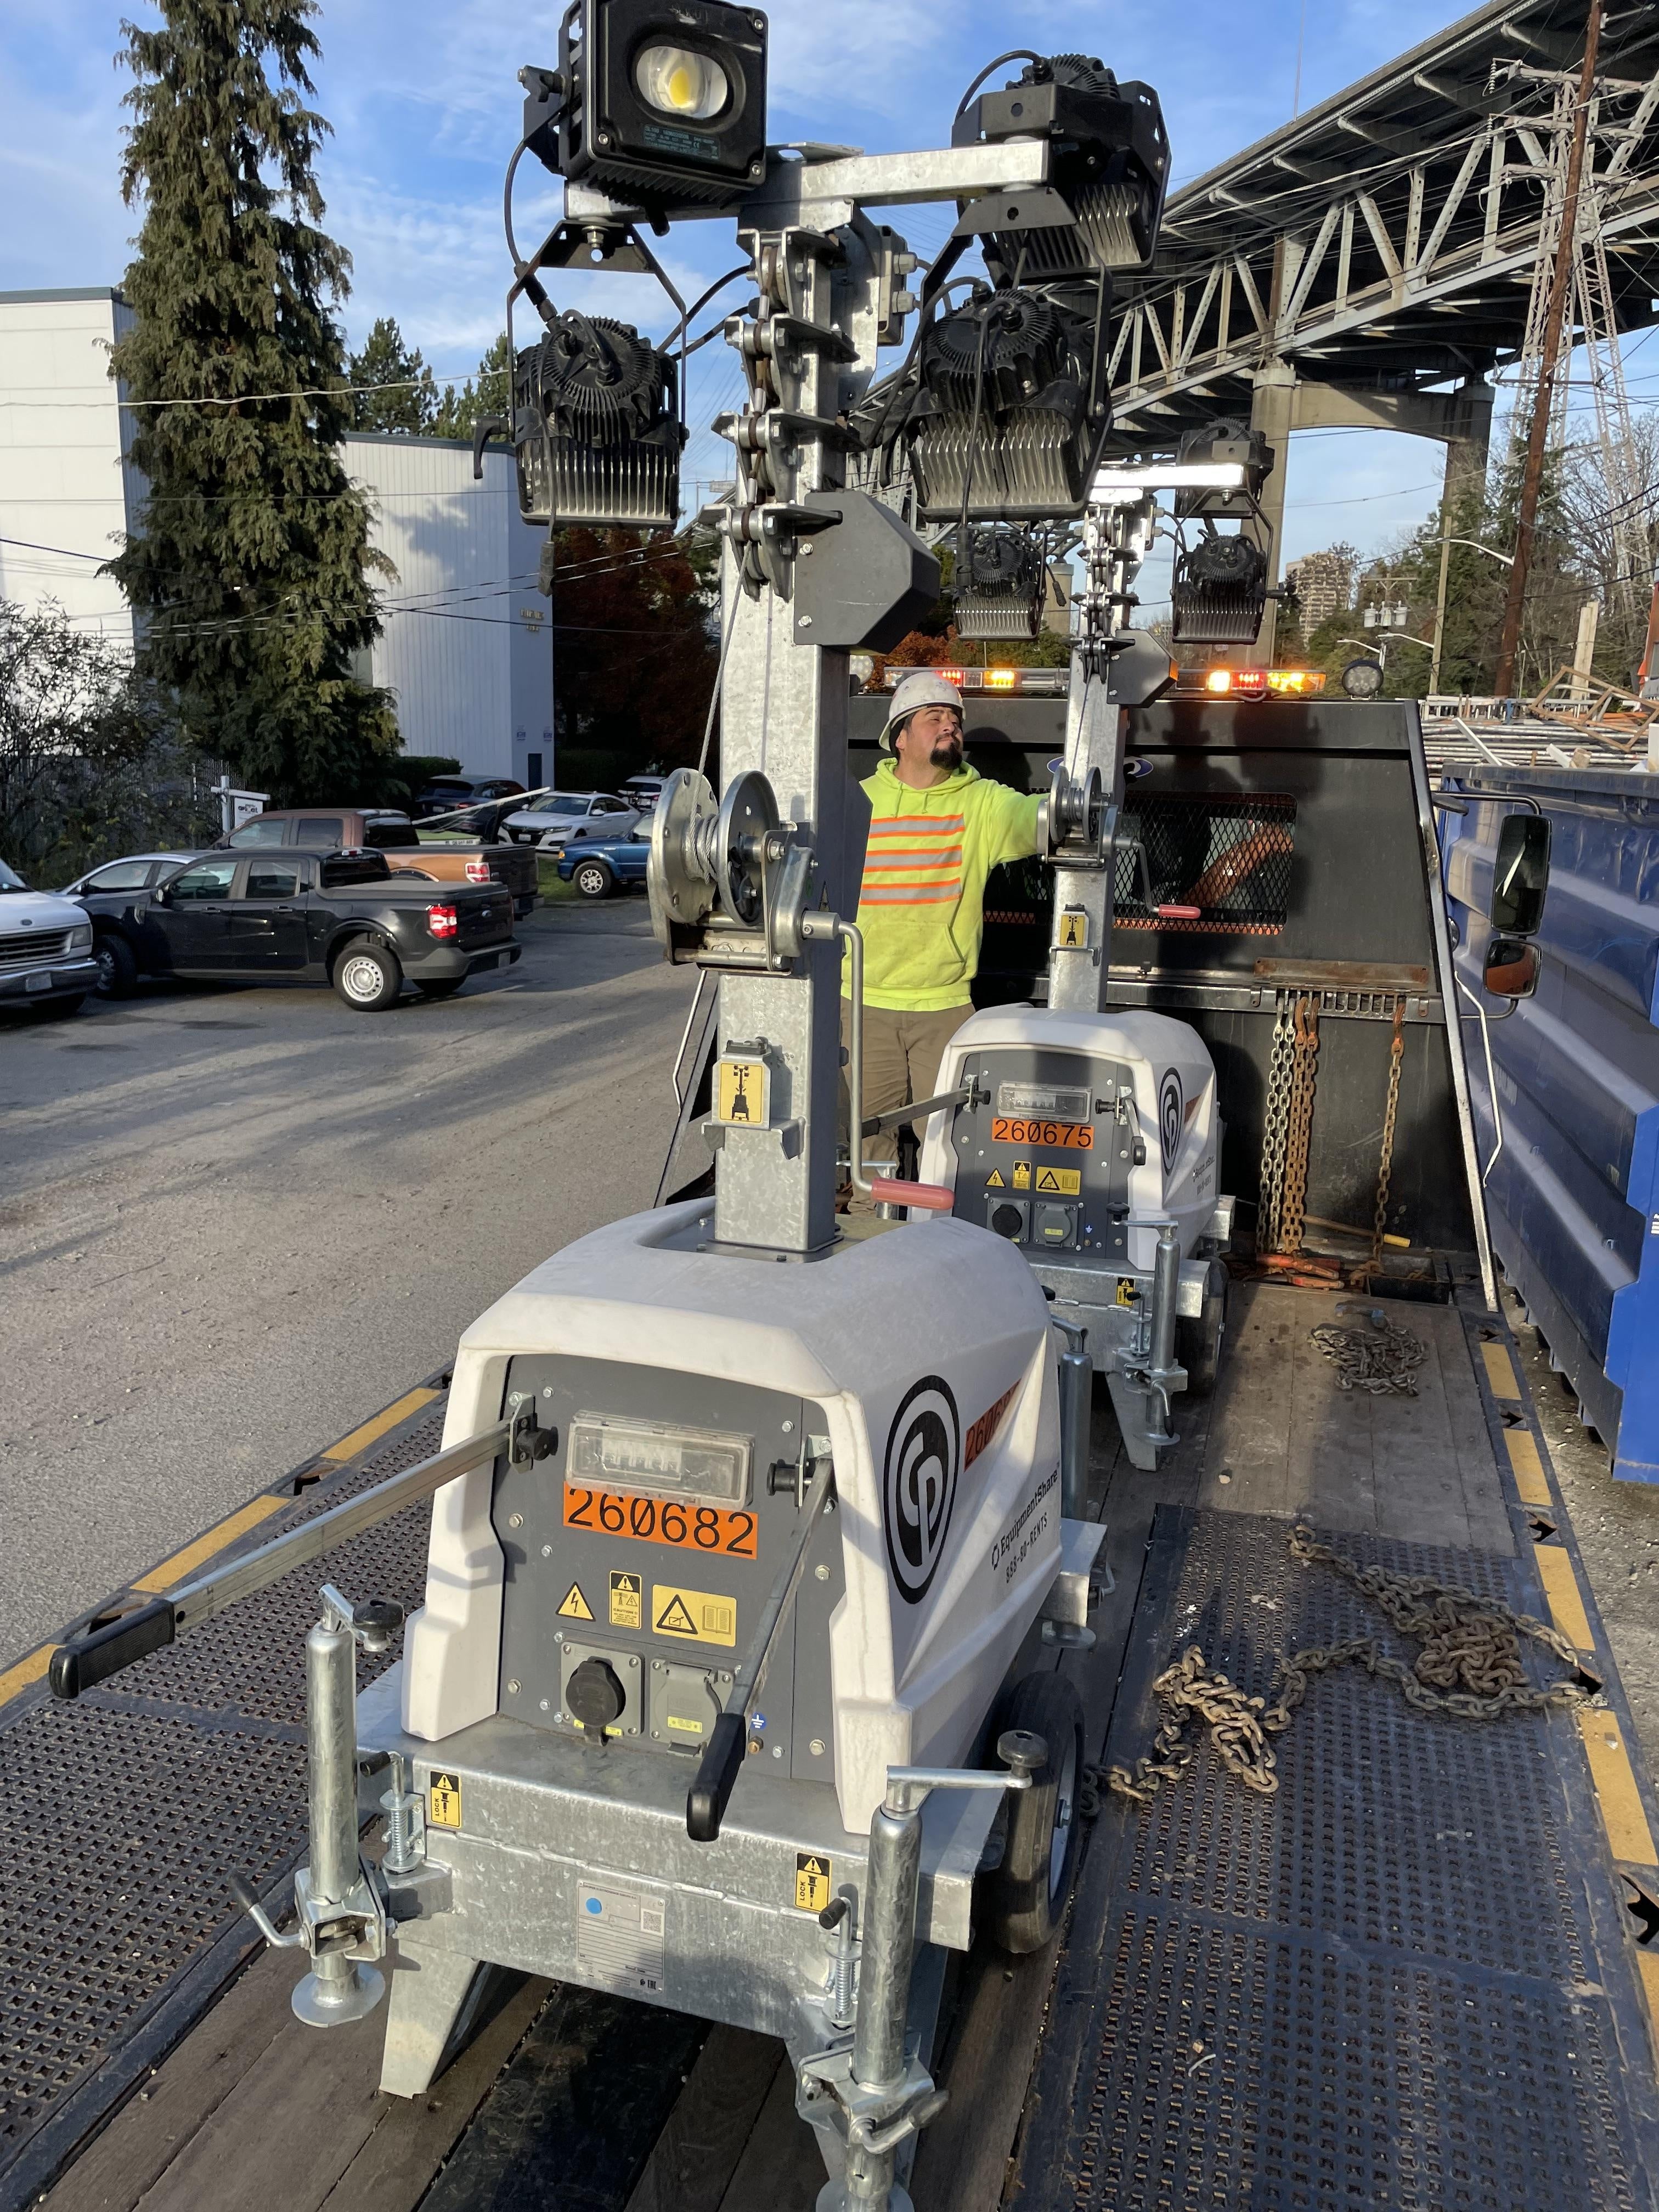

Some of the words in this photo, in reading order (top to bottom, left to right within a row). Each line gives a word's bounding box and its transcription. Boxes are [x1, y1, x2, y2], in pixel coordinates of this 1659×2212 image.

[994, 1119, 1091, 1147] 260675
[965, 1381, 1019, 1468] 2606
[568, 1488, 753, 1554] 260682
[1001, 1469, 1058, 1556] EquipmentShare
[1006, 1512, 1047, 1584] 888-80-RENTS
